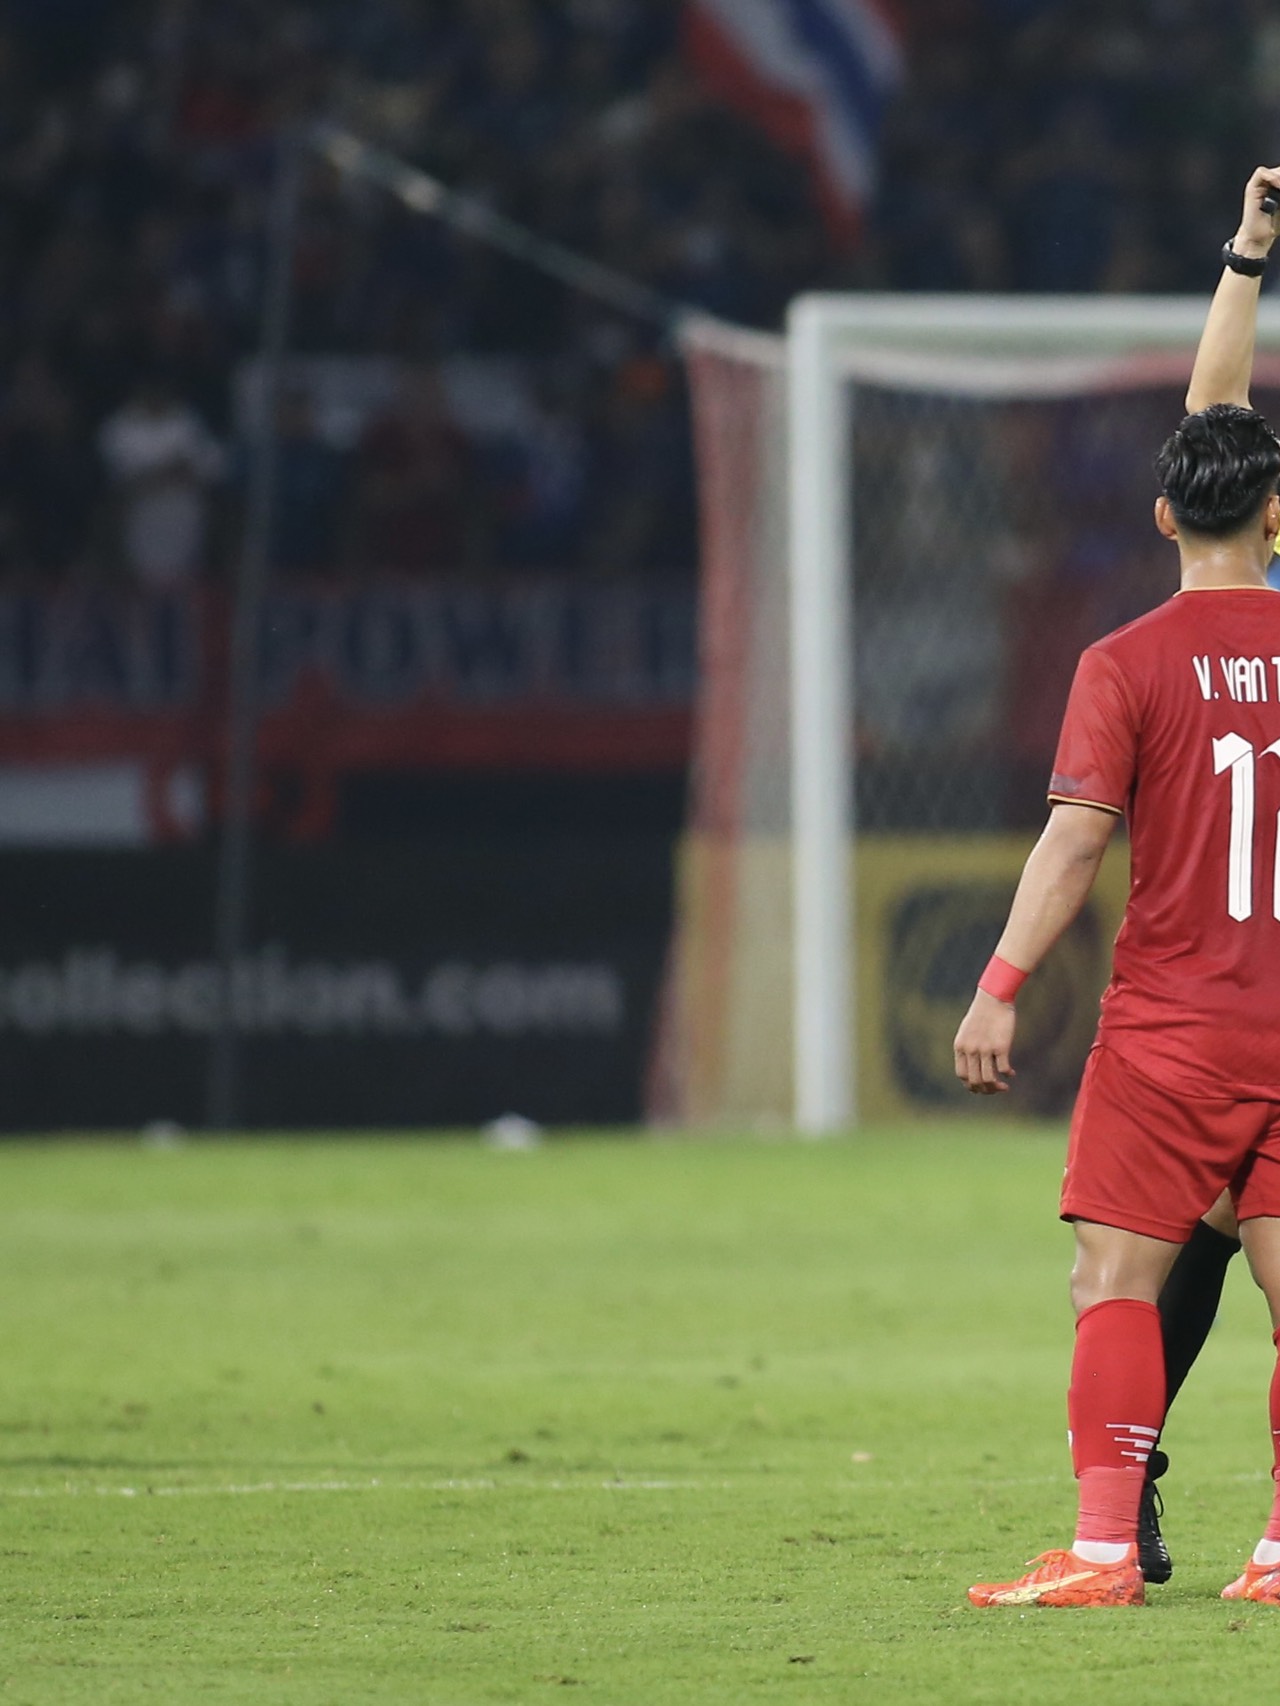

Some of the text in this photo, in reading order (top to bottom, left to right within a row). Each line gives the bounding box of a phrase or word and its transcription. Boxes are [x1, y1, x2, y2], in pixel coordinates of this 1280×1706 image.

[1192, 655, 1219, 700] V.
[1219, 656, 1268, 702] VAN
[0, 945, 622, 1036] ollection.com
